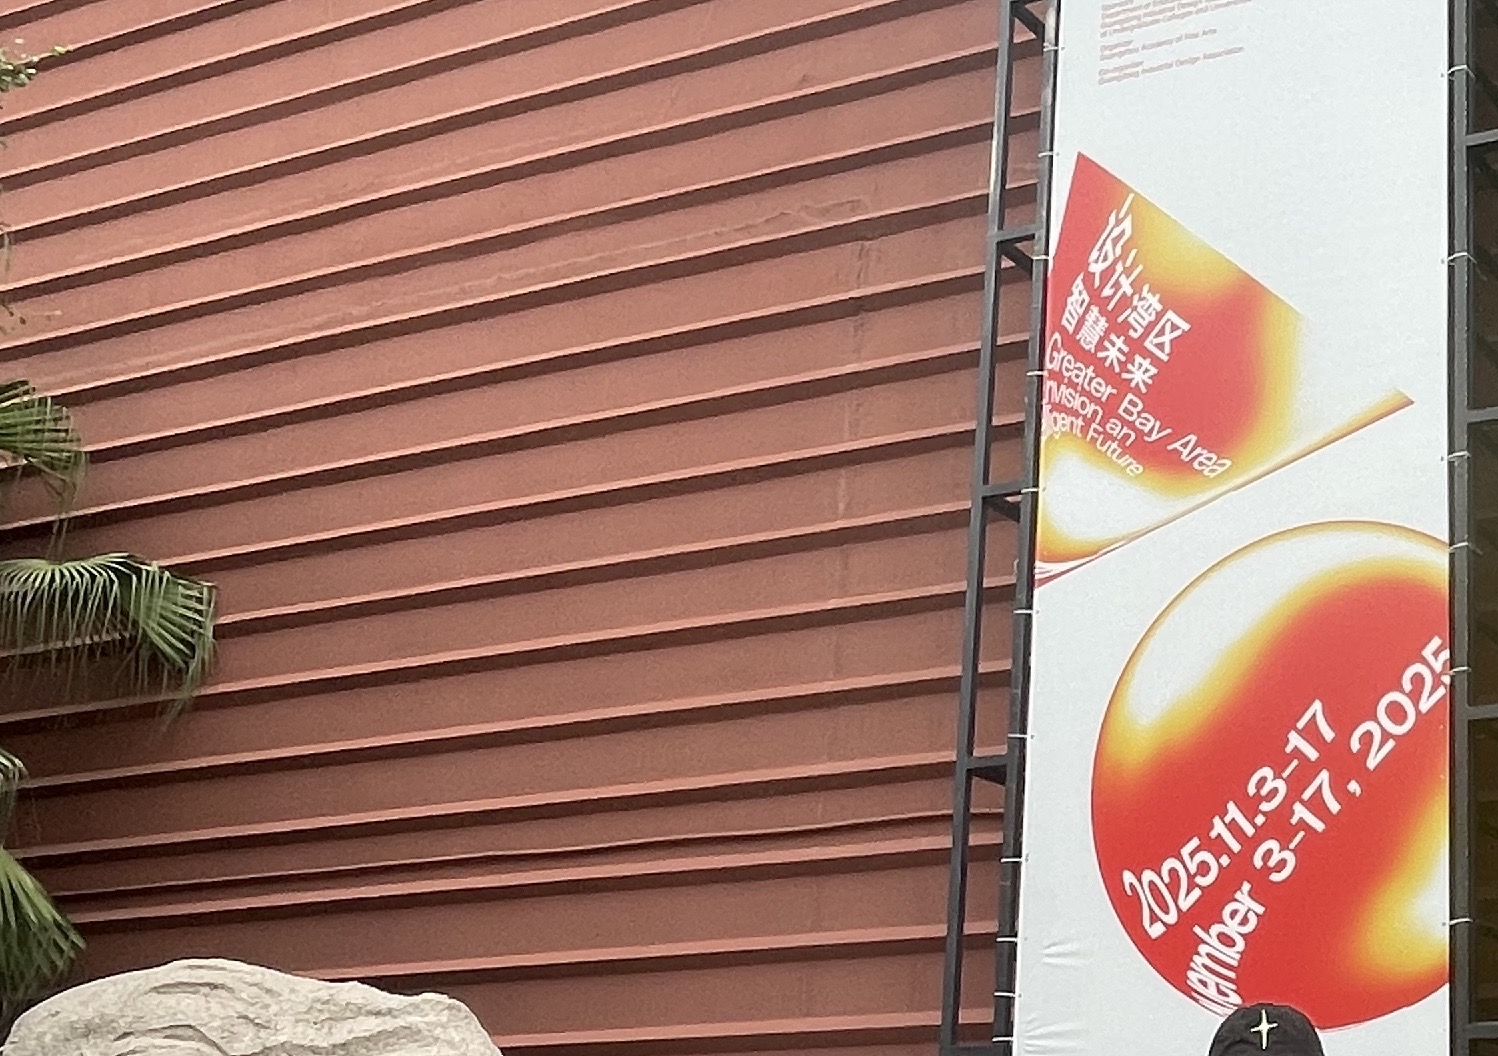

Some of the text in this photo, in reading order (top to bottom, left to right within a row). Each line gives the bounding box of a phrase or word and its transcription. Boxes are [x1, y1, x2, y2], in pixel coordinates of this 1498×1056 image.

[1060, 272, 1158, 393] 智慧未来
[1088, 193, 1191, 361] 设计湾区
[1045, 332, 1232, 479] Greater Bay Area
[1087, 423, 1144, 476] Future
[1105, 418, 1136, 447] an
